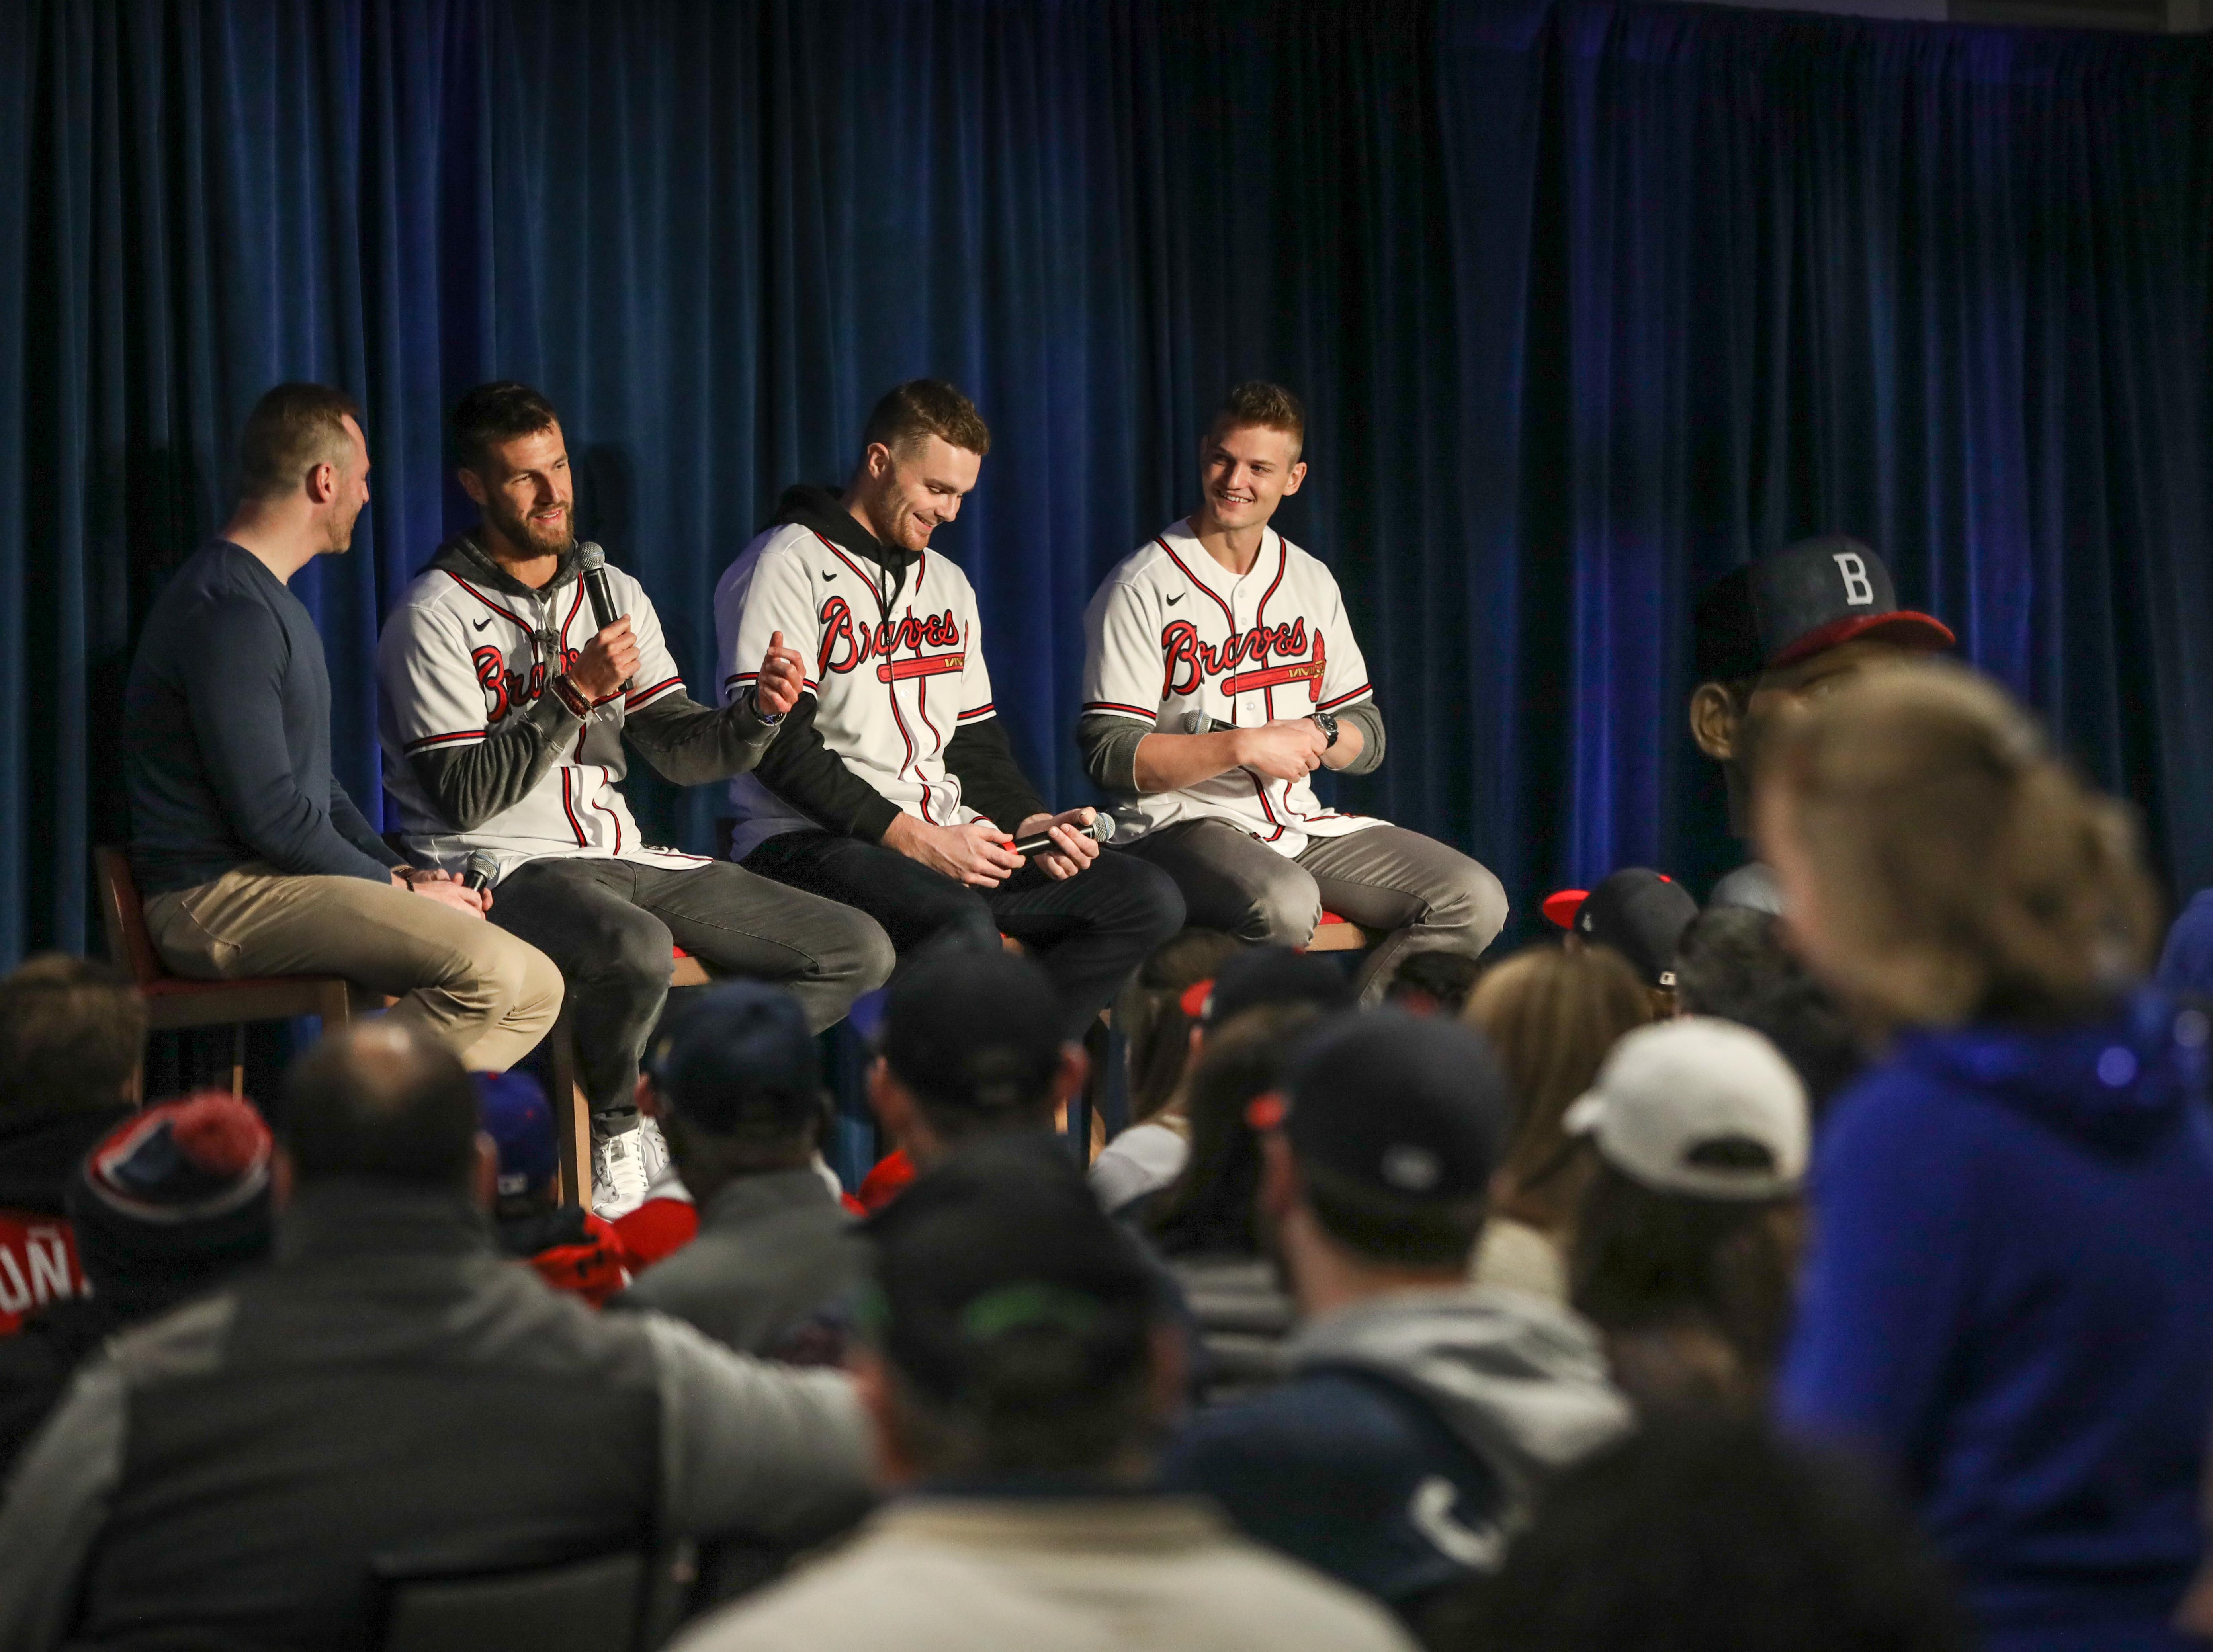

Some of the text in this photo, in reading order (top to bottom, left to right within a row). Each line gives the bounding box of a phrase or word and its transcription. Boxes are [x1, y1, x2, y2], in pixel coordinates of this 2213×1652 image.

[1832, 552, 1874, 606] B
[817, 595, 959, 681] Braves
[1161, 619, 1308, 702] Braves
[471, 644, 580, 723] Bra
[0, 1225, 96, 1313] UÑ
